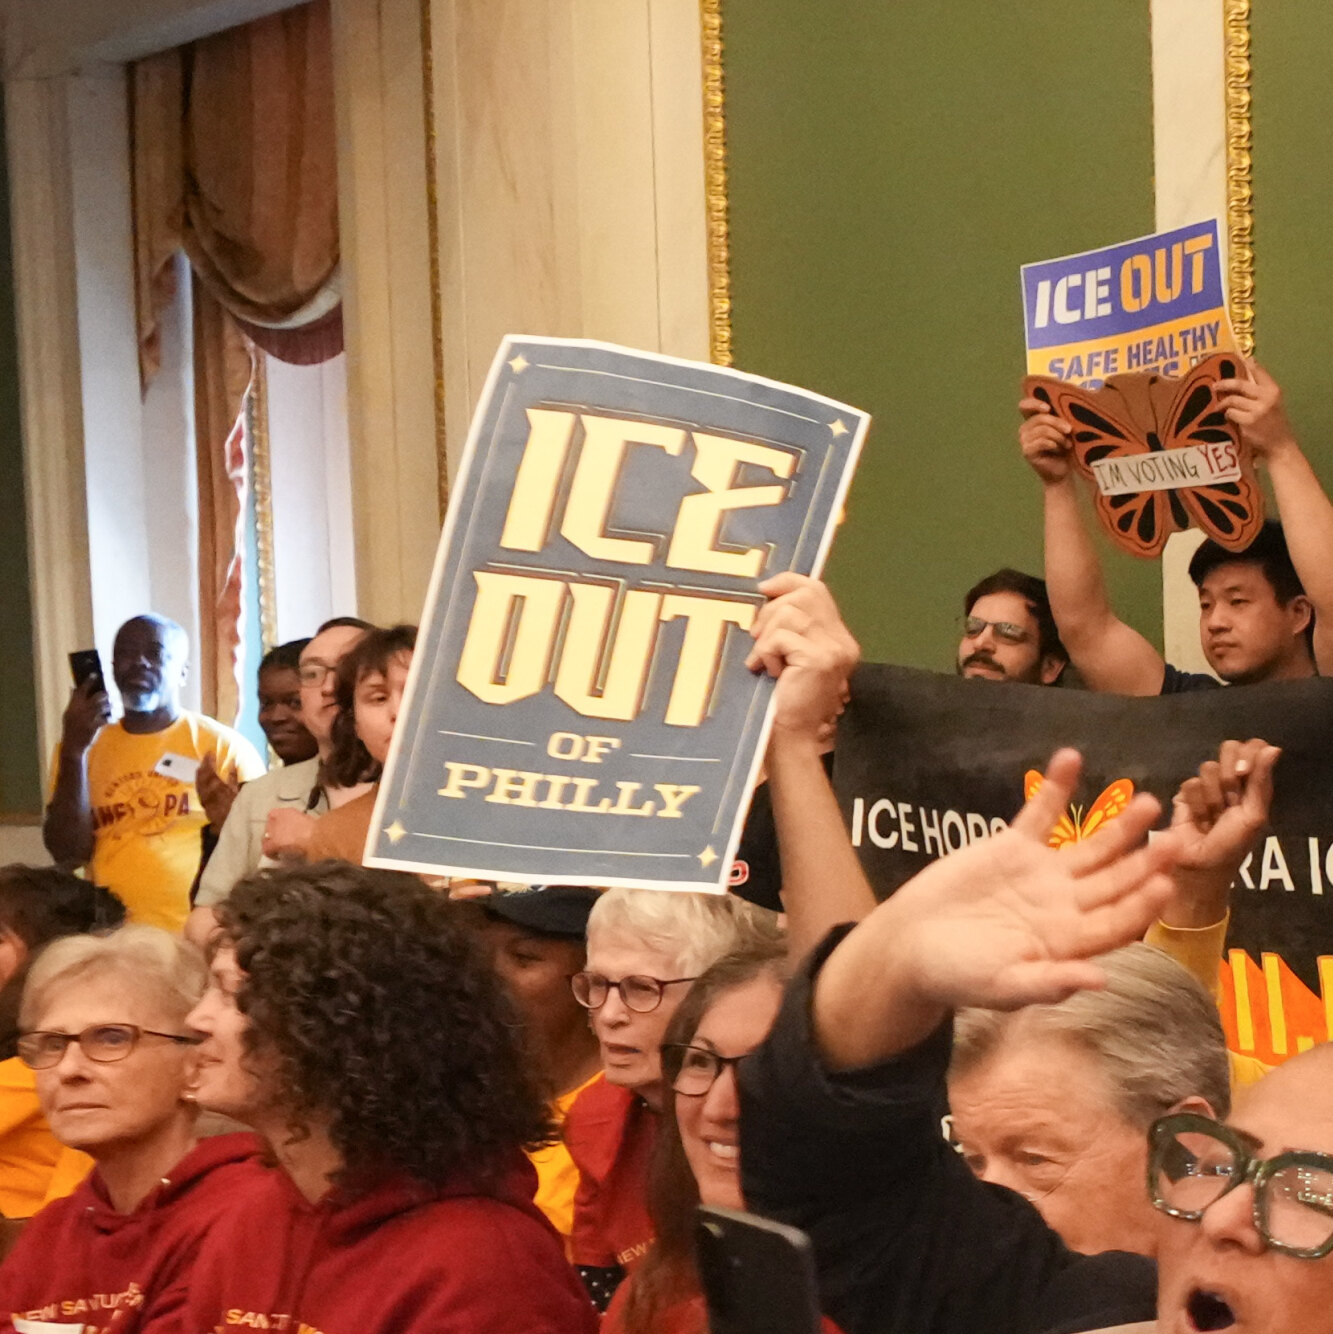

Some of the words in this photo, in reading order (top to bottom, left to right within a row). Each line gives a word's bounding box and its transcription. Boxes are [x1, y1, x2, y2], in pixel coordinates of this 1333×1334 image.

[1034, 266, 1113, 329] ICE
[1119, 233, 1213, 313] OUT
[1048, 348, 1119, 382] SAFE
[1127, 320, 1221, 370] HEALTHY
[500, 405, 803, 579] ICE
[1128, 452, 1200, 485] VOTING
[1197, 444, 1238, 475] YES
[455, 570, 764, 728] OUT
[547, 731, 622, 763] OF
[437, 761, 702, 818] PHILLY
[852, 797, 918, 852] ICE
